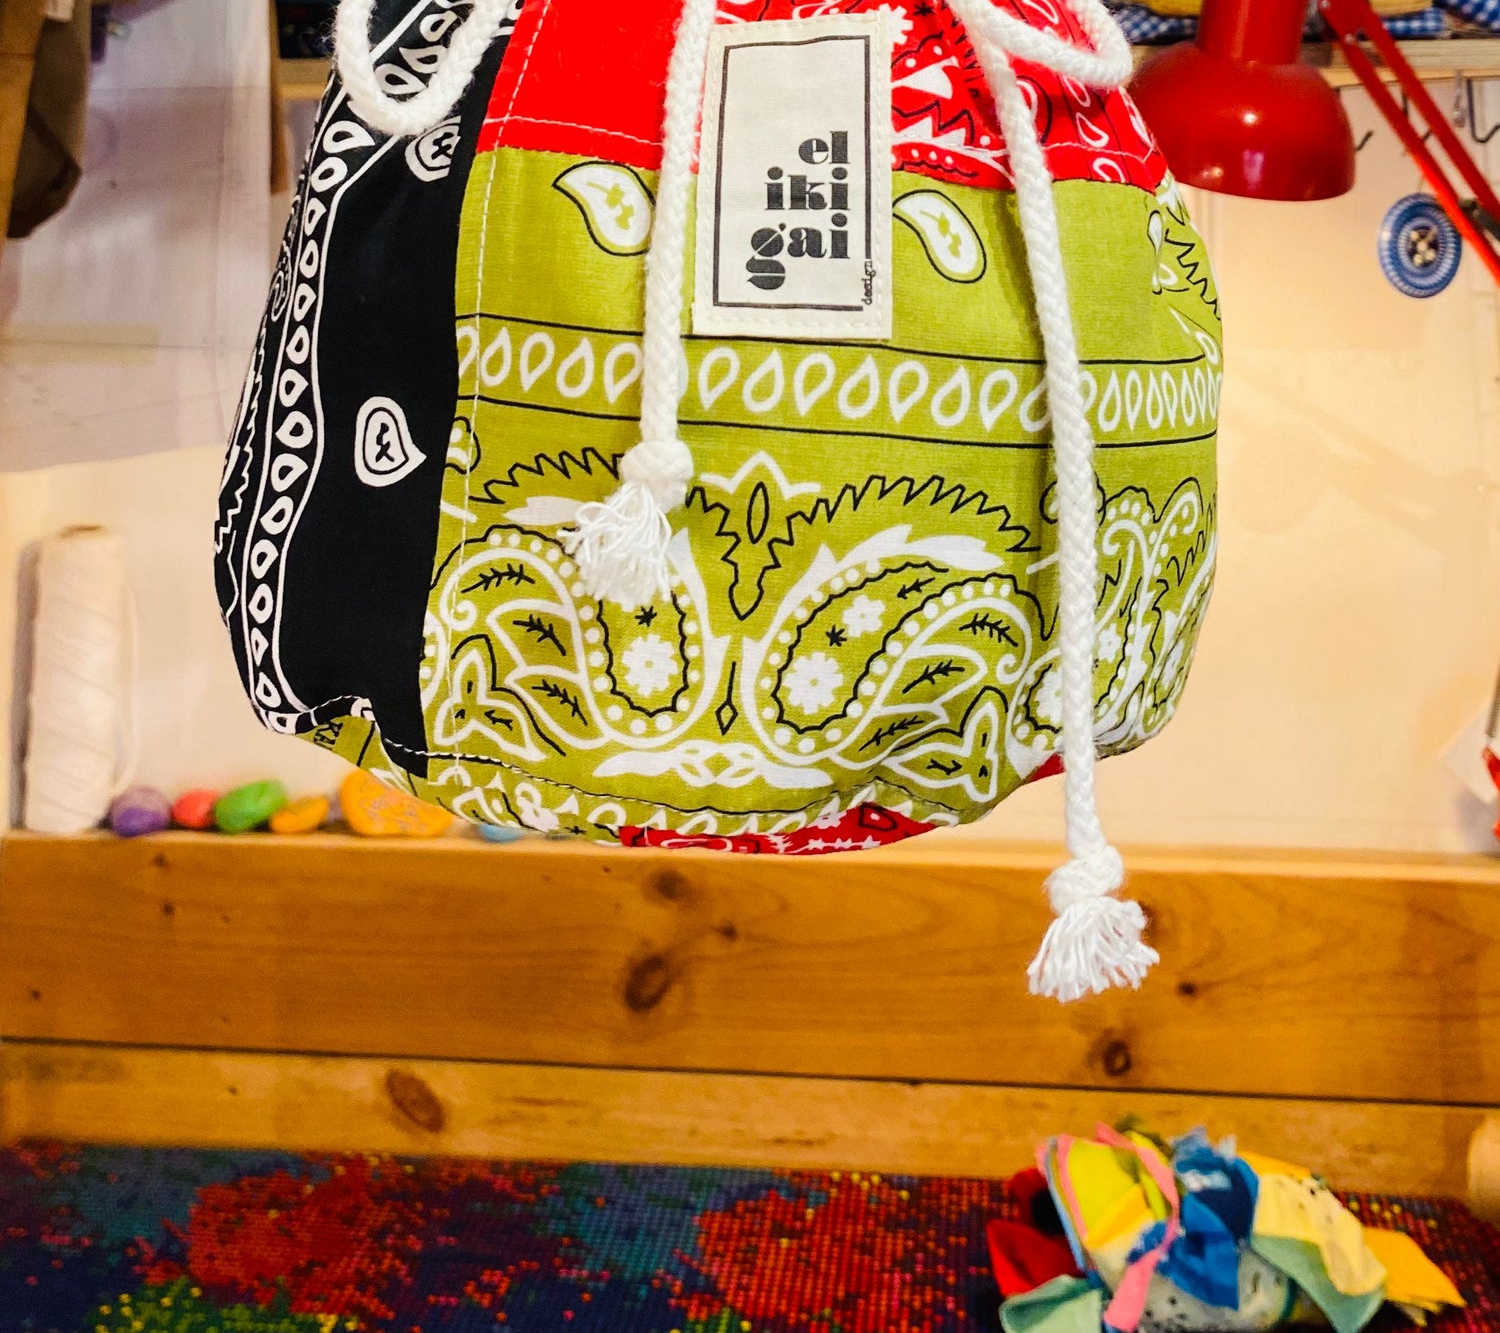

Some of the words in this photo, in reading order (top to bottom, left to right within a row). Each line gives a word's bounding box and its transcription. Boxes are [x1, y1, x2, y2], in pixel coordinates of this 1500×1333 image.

[799, 131, 850, 164] el
[765, 166, 850, 210] iki
[746, 213, 850, 290] gai
[861, 260, 876, 305] design
